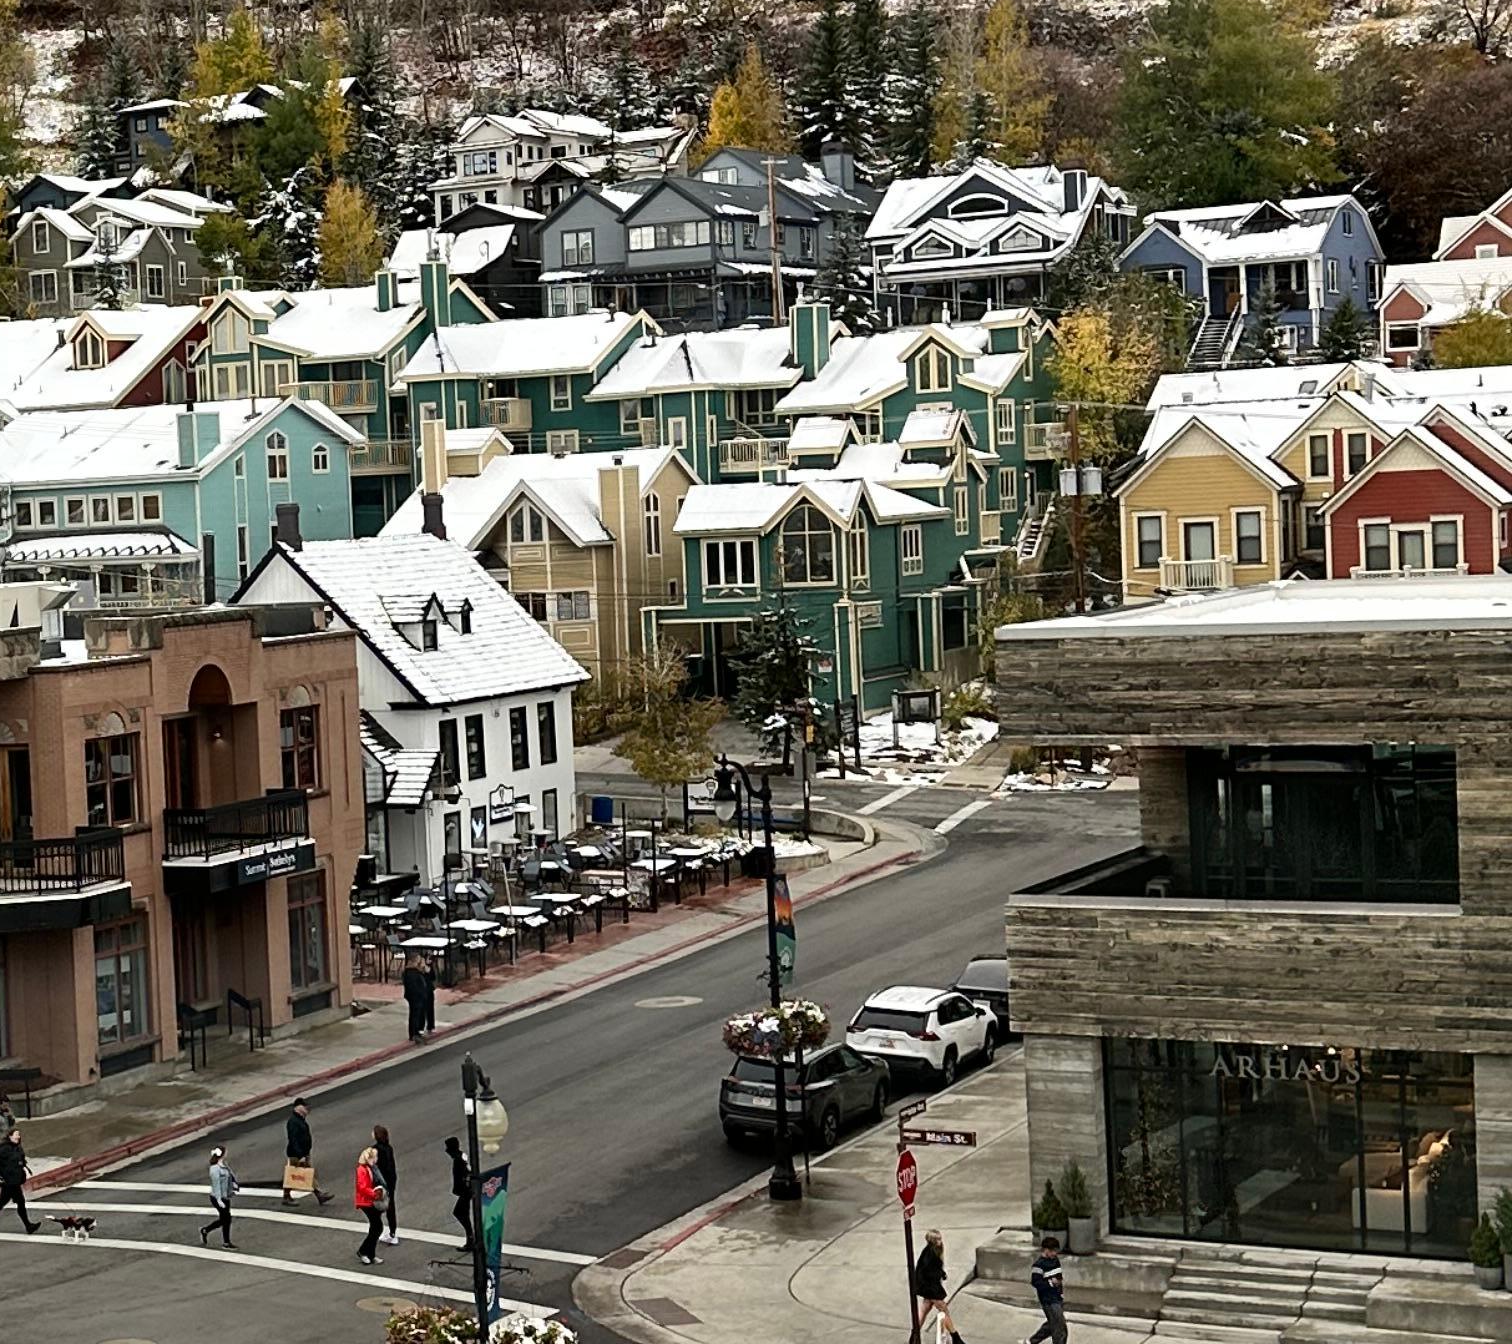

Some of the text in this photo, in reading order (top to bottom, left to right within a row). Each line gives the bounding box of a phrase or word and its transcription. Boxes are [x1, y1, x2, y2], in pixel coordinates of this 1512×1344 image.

[1208, 1055, 1361, 1084] ARHAUS
[925, 1132, 952, 1143] Main
[898, 1165, 916, 1193] STOP
